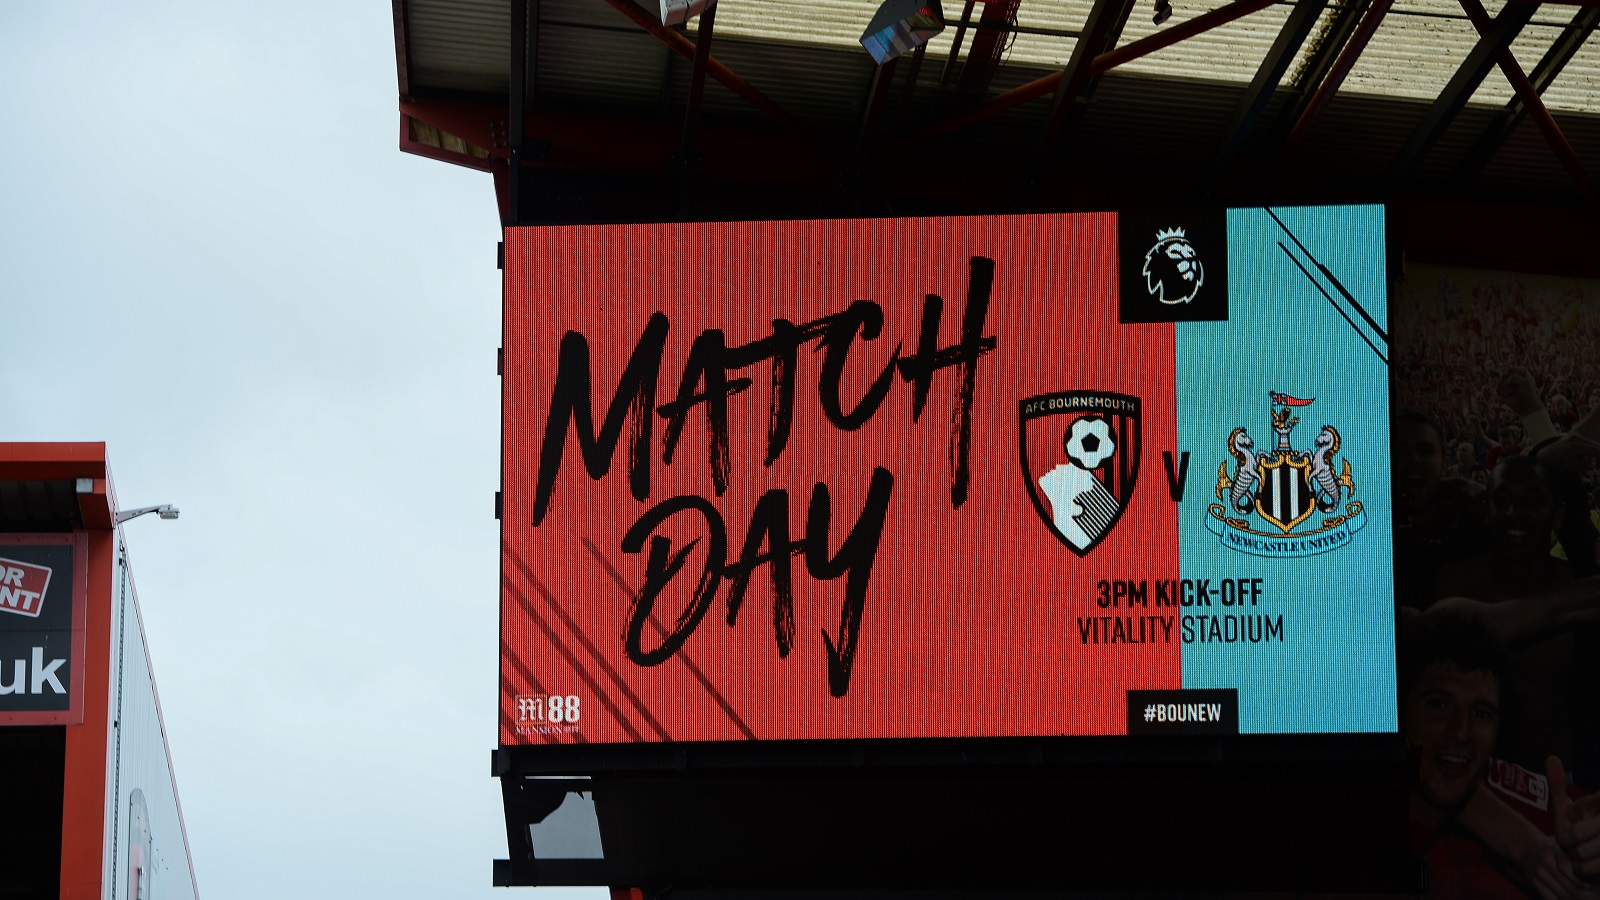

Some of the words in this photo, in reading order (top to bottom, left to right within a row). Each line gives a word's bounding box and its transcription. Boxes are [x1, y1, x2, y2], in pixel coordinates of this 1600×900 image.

[532, 256, 997, 527] MATCH
[1025, 397, 1046, 414] AFC
[1049, 396, 1135, 412] BOURNEMOUTH
[1163, 451, 1190, 503] V
[1228, 530, 1298, 552] NEWCASTLE
[1299, 531, 1347, 551] UNITED
[621, 466, 894, 699] DAY
[1097, 579, 1147, 607] 3PM
[1155, 578, 1263, 607] KICK-OFF
[1078, 615, 1174, 644] VITALITY
[1181, 614, 1284, 643] STADIUM
[1143, 703, 1222, 722] #BOUNEW
